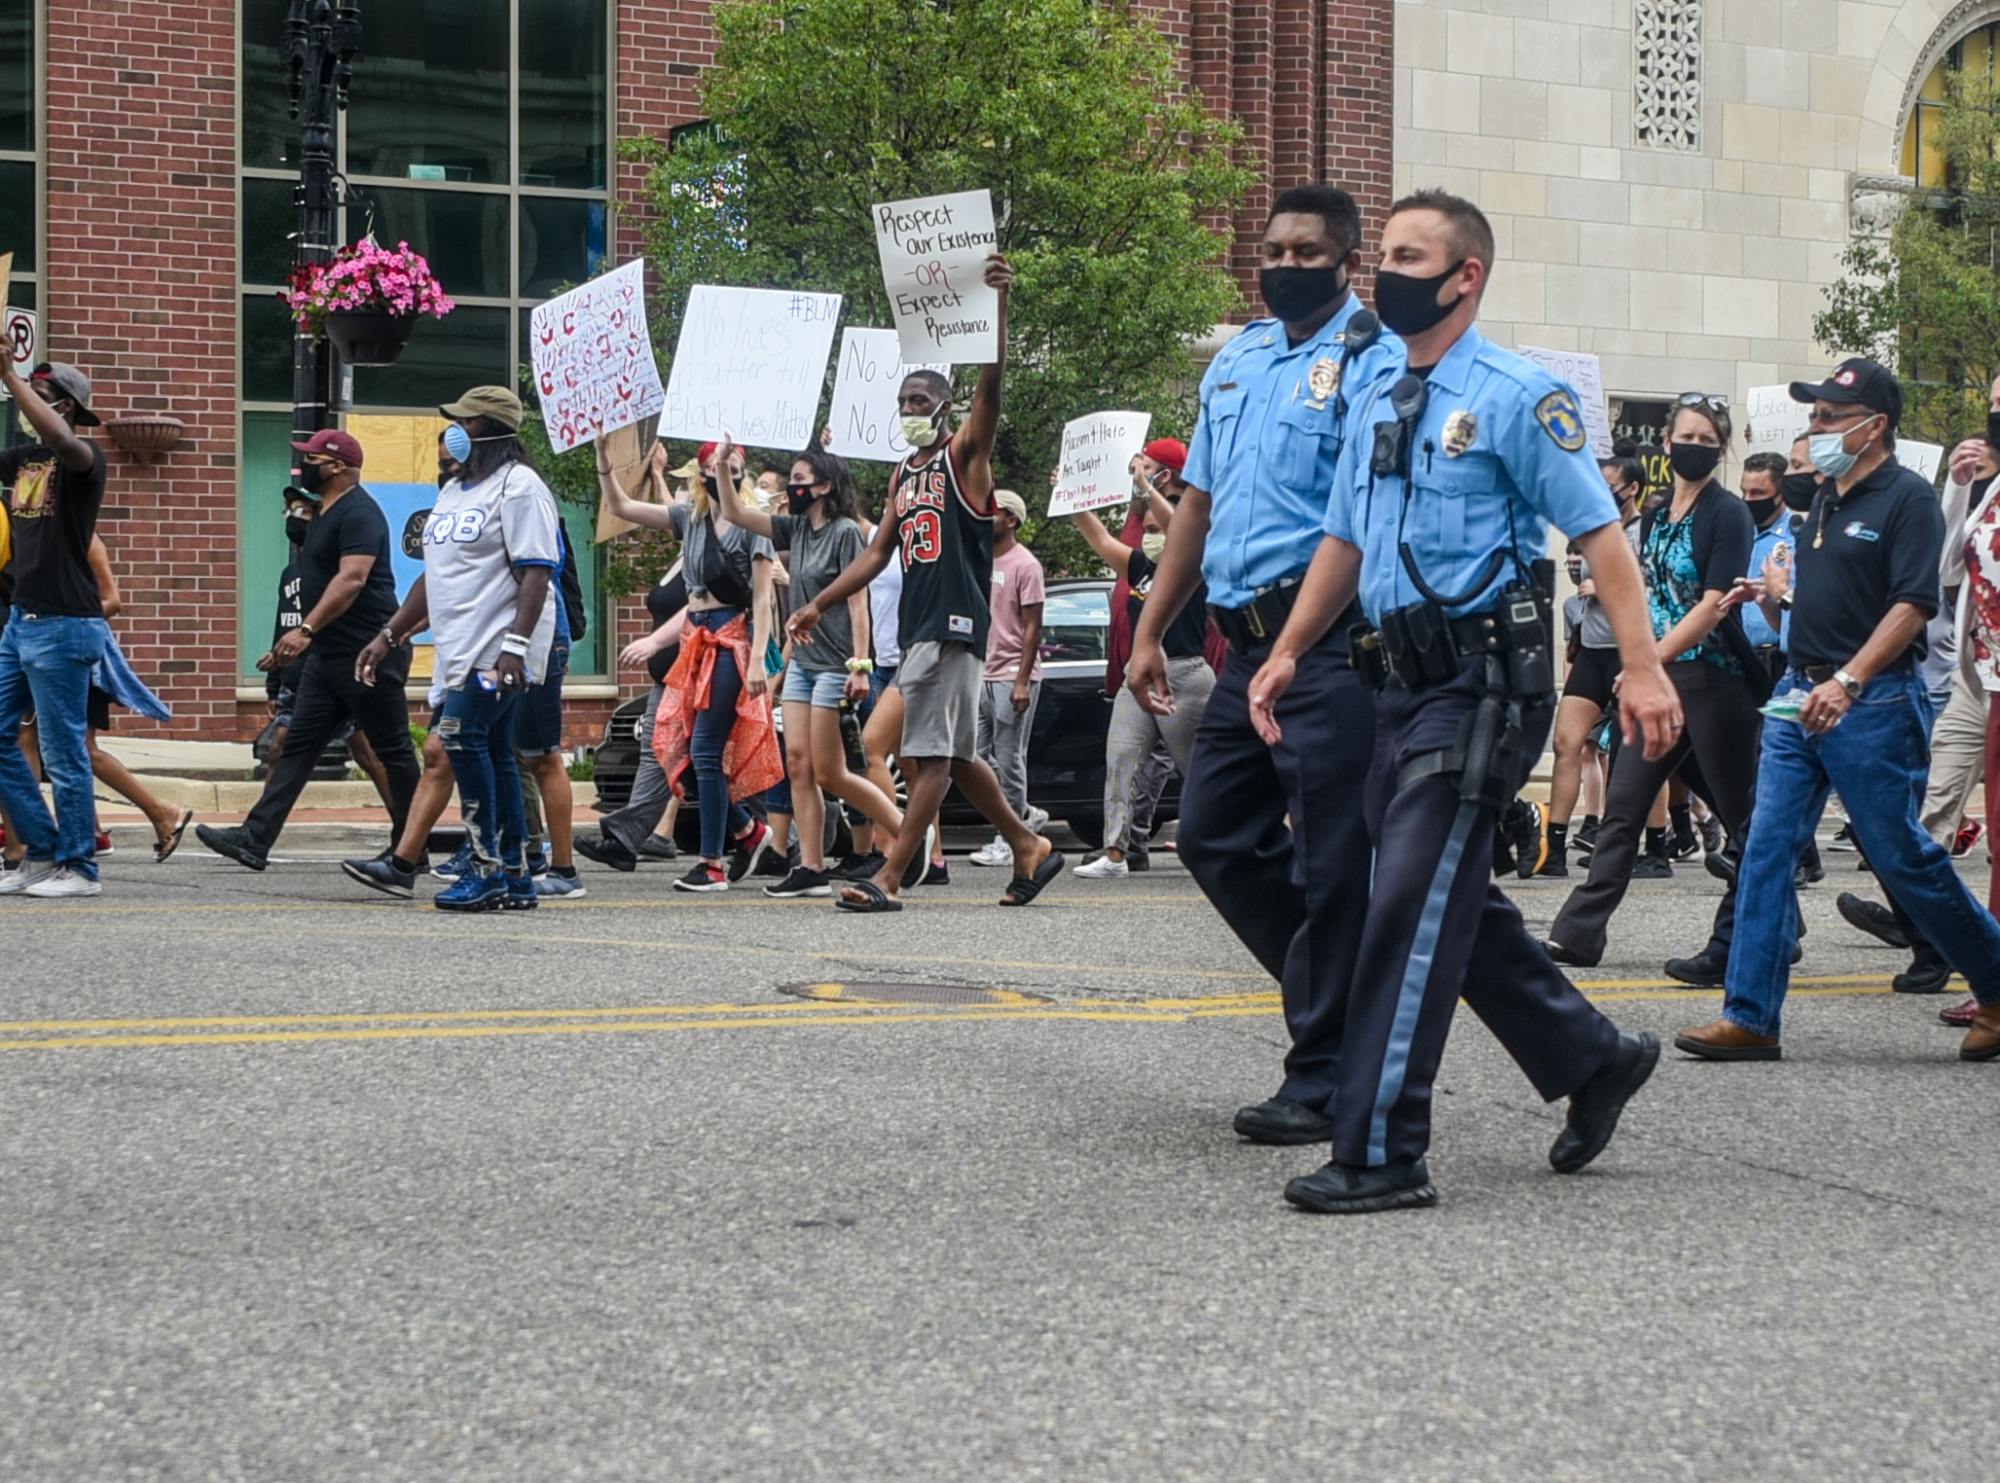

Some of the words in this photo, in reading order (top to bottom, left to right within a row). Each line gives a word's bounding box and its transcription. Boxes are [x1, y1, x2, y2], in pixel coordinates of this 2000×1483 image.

[879, 204, 953, 247] Respect
[788, 294, 838, 324] #BLM
[896, 291, 964, 316] Expect
[690, 293, 726, 356] No
[925, 316, 990, 348] Resistance
[845, 338, 876, 382] No
[665, 392, 734, 432] Black
[848, 402, 877, 444] No
[1641, 454, 1672, 483] ACK
[896, 471, 945, 518] ULLS
[284, 577, 301, 599] DET
